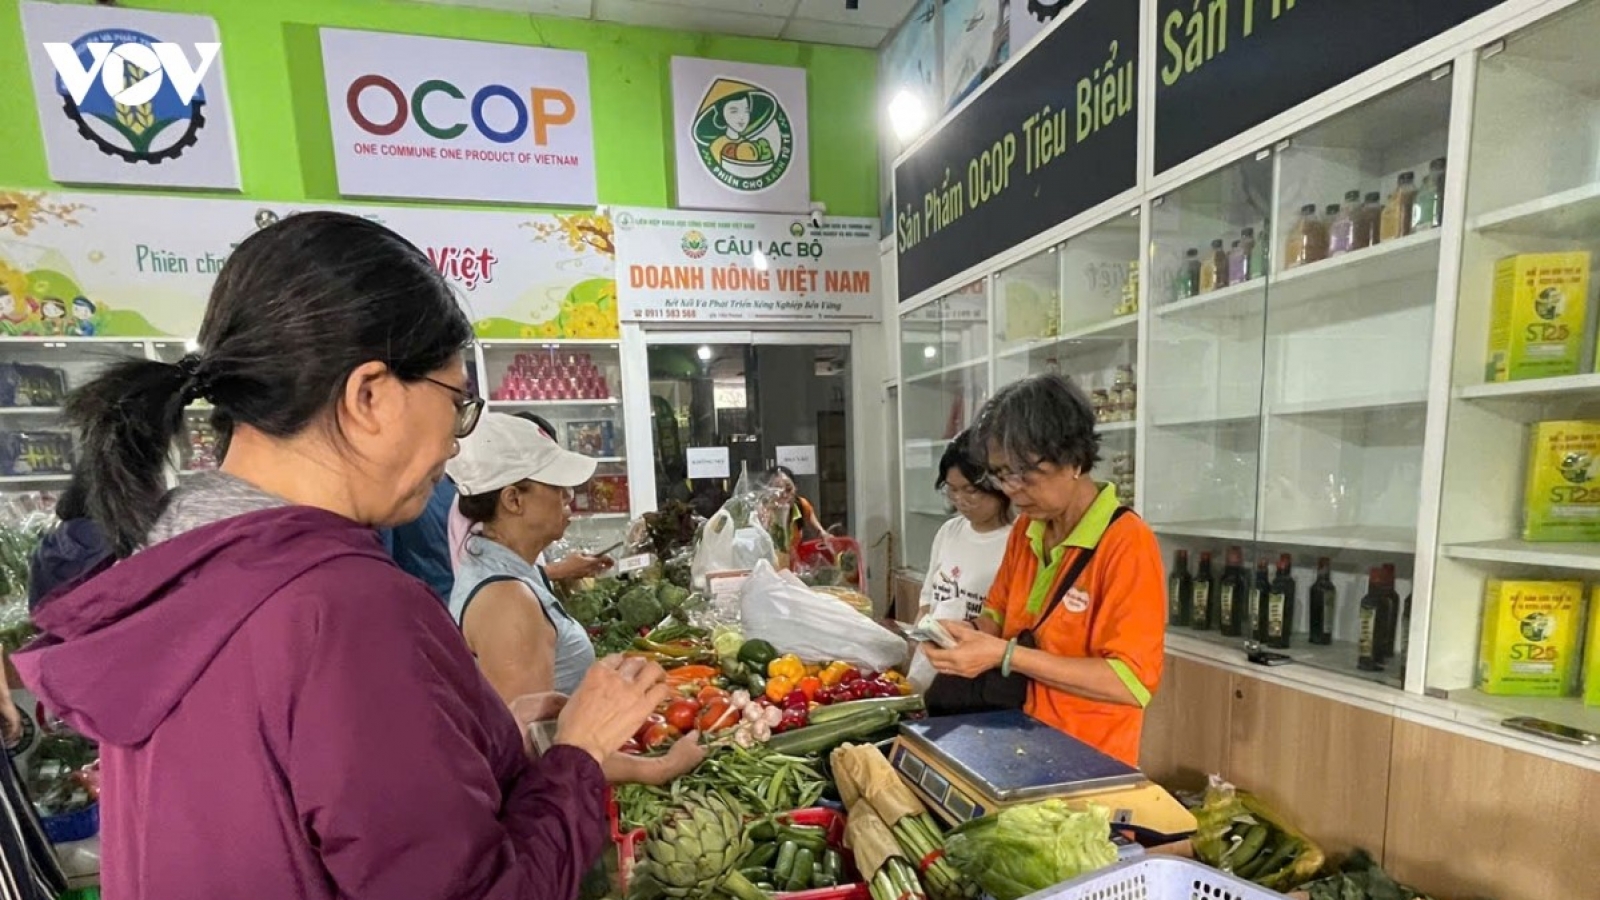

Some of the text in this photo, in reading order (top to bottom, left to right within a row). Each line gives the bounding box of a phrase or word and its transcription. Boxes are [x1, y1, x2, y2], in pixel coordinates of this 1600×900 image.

[346, 74, 576, 146] OCOP
[354, 143, 578, 167] ONE COMMUNE ONE PRODUCT OF VIETNAM
[899, 40, 1133, 254] Sản Phẩm OCOP Tiêu Biểu
[136, 244, 188, 273] Phiên
[714, 236, 823, 261] CÂU LẠC BỘ
[427, 246, 498, 290] Việt
[629, 263, 870, 296] DOANH NÔNG VIỆT NAM
[1526, 323, 1569, 342] ST25
[1509, 643, 1560, 661] ST25
